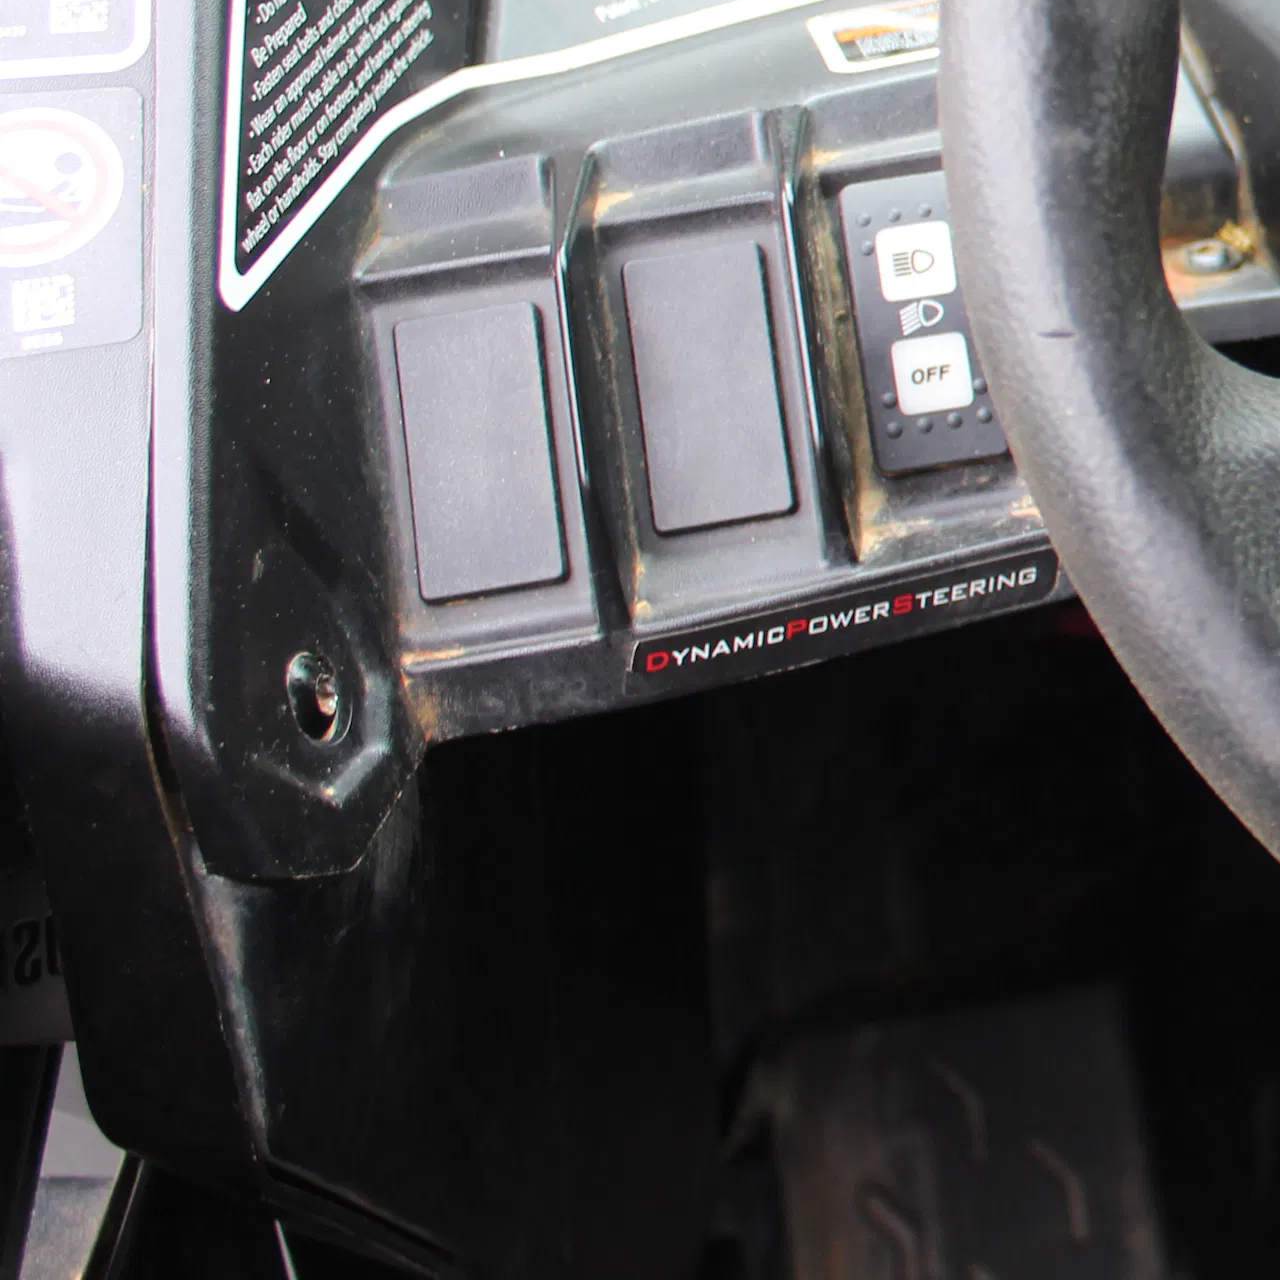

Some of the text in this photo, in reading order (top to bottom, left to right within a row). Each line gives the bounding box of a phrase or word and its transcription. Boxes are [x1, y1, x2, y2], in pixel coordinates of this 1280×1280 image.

[250, 1, 307, 69] Be Prepared
[252, 64, 285, 100] Fasten
[281, 44, 302, 73] seat
[296, 25, 320, 55] belts
[317, 5, 335, 35] and
[257, 1, 276, 23] Do
[246, 186, 266, 212] flat
[262, 174, 277, 196] on
[272, 158, 292, 182] the
[286, 136, 309, 167] floor
[306, 125, 318, 145] or
[315, 114, 330, 135] on
[355, 60, 373, 89] and
[367, 39, 394, 73] hands
[390, 29, 404, 49] on
[400, 0, 432, 39] steering
[248, 141, 274, 174] Each
[270, 121, 293, 151] rider
[290, 97, 314, 130] must
[307, 88, 324, 109] be
[320, 69, 340, 97] able
[335, 60, 348, 78] to
[345, 47, 358, 69] sit
[354, 30, 374, 58] with
[368, 11, 391, 41] back
[250, 104, 277, 136] Wear
[274, 93, 289, 114] an
[285, 50, 324, 102] approved
[319, 24, 350, 63] helmet
[346, 6, 365, 36] and
[241, 212, 271, 253] wheel
[267, 204, 280, 224] or
[275, 157, 322, 213] handholds.
[317, 136, 338, 165] Stay
[335, 92, 376, 145] completely
[371, 68, 397, 101] inside
[392, 54, 409, 77] the
[911, 363, 952, 386] OFF
